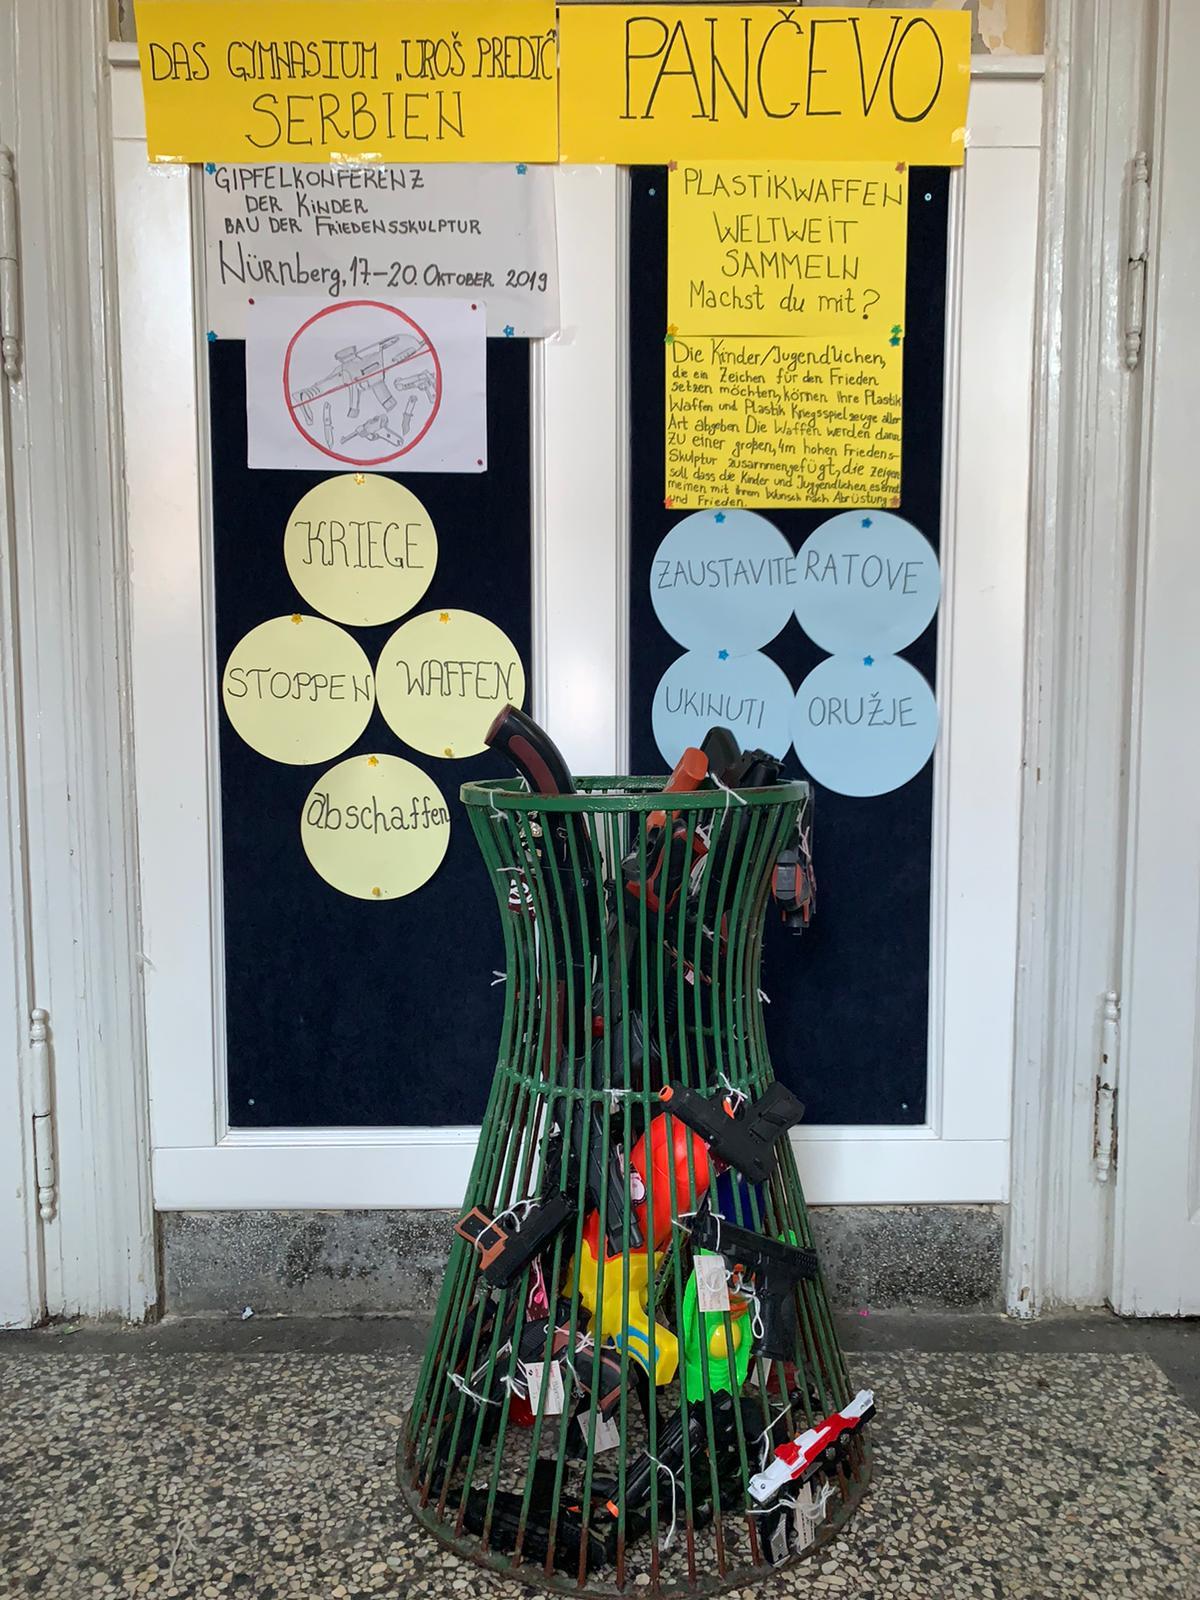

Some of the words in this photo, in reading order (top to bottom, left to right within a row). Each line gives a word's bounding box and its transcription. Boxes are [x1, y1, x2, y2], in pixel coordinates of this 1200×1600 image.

[149, 42, 210, 81] DAS
[227, 40, 379, 82] GYMNASIUM
[619, 9, 944, 123] PANČEVO
[244, 91, 466, 148] SERBIEN
[214, 165, 425, 193] GIPFELKONFERENZ
[245, 194, 283, 214] DER
[224, 218, 260, 234] BAU
[269, 216, 302, 234] DER
[721, 248, 860, 280] SAMMELN
[505, 268, 549, 293] 2019
[688, 280, 765, 311] Machst
[779, 283, 805, 313] du
[818, 287, 881, 321] mit?
[672, 340, 705, 364] Die
[693, 369, 709, 381] ein
[719, 366, 766, 384] Zeichen
[775, 367, 799, 385] für
[802, 370, 824, 384] den
[829, 367, 880, 386] Frieden
[669, 394, 714, 413] Waffen
[718, 399, 738, 413] und
[744, 398, 786, 417] Plastik
[667, 413, 689, 431] Art
[745, 413, 768, 435] Die
[773, 417, 821, 438] Waffen
[691, 433, 725, 451] einer
[778, 438, 797, 455] 4m
[802, 437, 838, 457] hohen
[668, 447, 718, 468] Skulptur
[841, 457, 866, 476] die
[669, 465, 688, 480] soll
[692, 466, 716, 482] dass
[740, 470, 768, 487] Kinder
[773, 477, 793, 488] und
[711, 483, 729, 495] mit
[294, 520, 424, 569] KRIEGE
[656, 556, 797, 589] ZAUSTAVITE
[804, 550, 924, 594] RATOVE
[227, 667, 371, 702] STOPPEN
[396, 659, 516, 701] WAFFEN
[665, 686, 765, 729] UKINUTI
[808, 691, 917, 728] ORUŽJE
